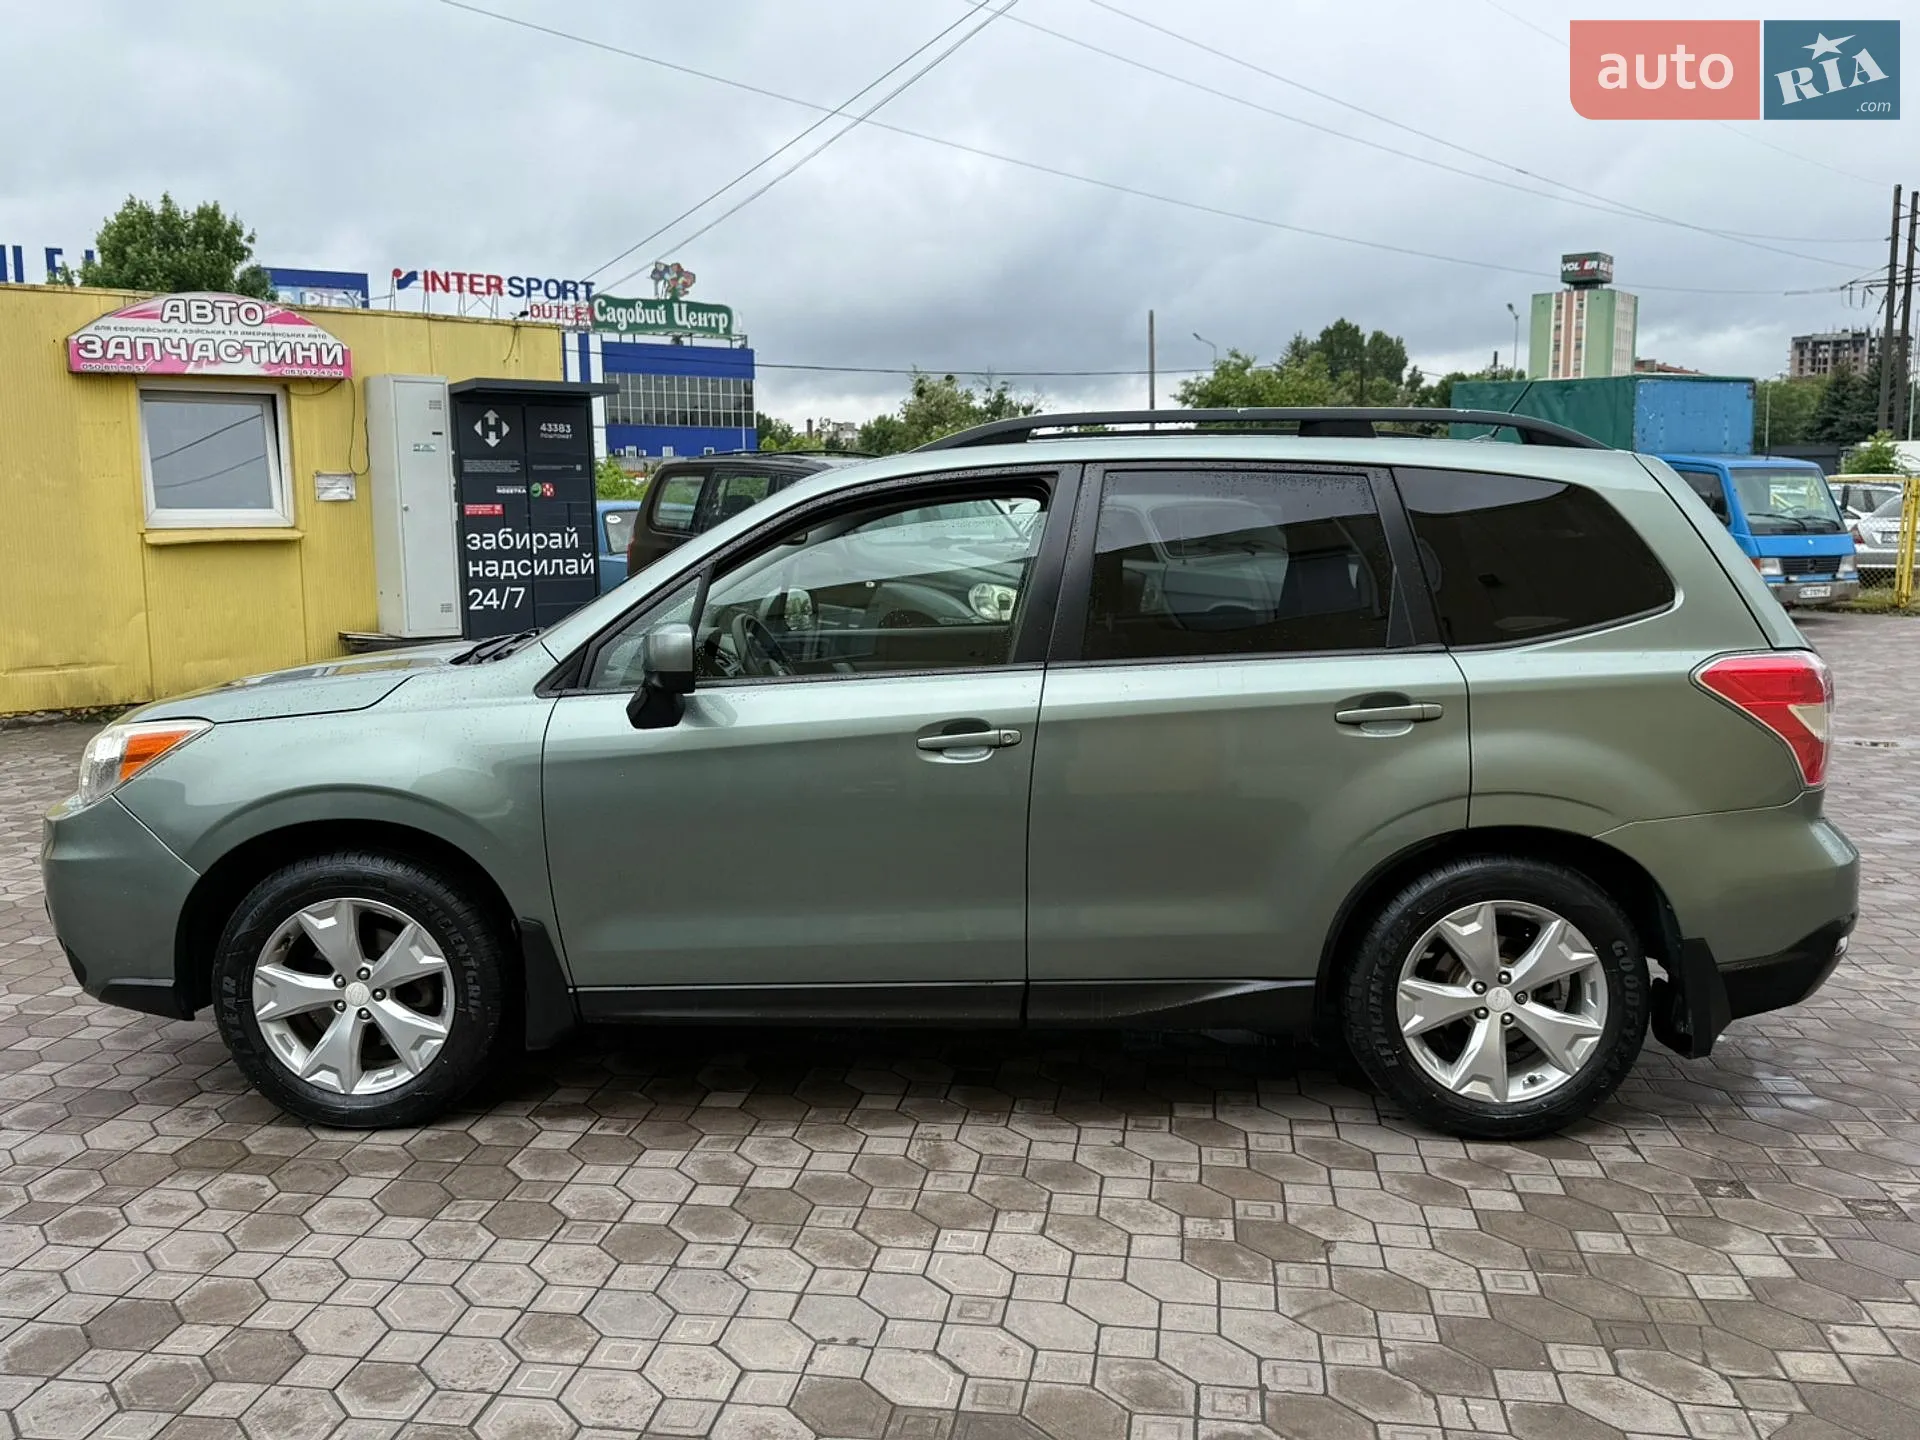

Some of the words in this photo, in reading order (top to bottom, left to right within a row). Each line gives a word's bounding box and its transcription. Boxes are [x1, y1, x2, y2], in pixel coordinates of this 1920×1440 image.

[160, 298, 264, 327] АВТО
[594, 298, 666, 331] Садовий
[673, 302, 728, 334] Центр
[77, 334, 345, 367] ЗАПЧАСТИНИ
[540, 422, 571, 433] 43383
[466, 527, 578, 554] забирай
[468, 552, 595, 579] надсилай
[468, 586, 525, 610] 24/7
